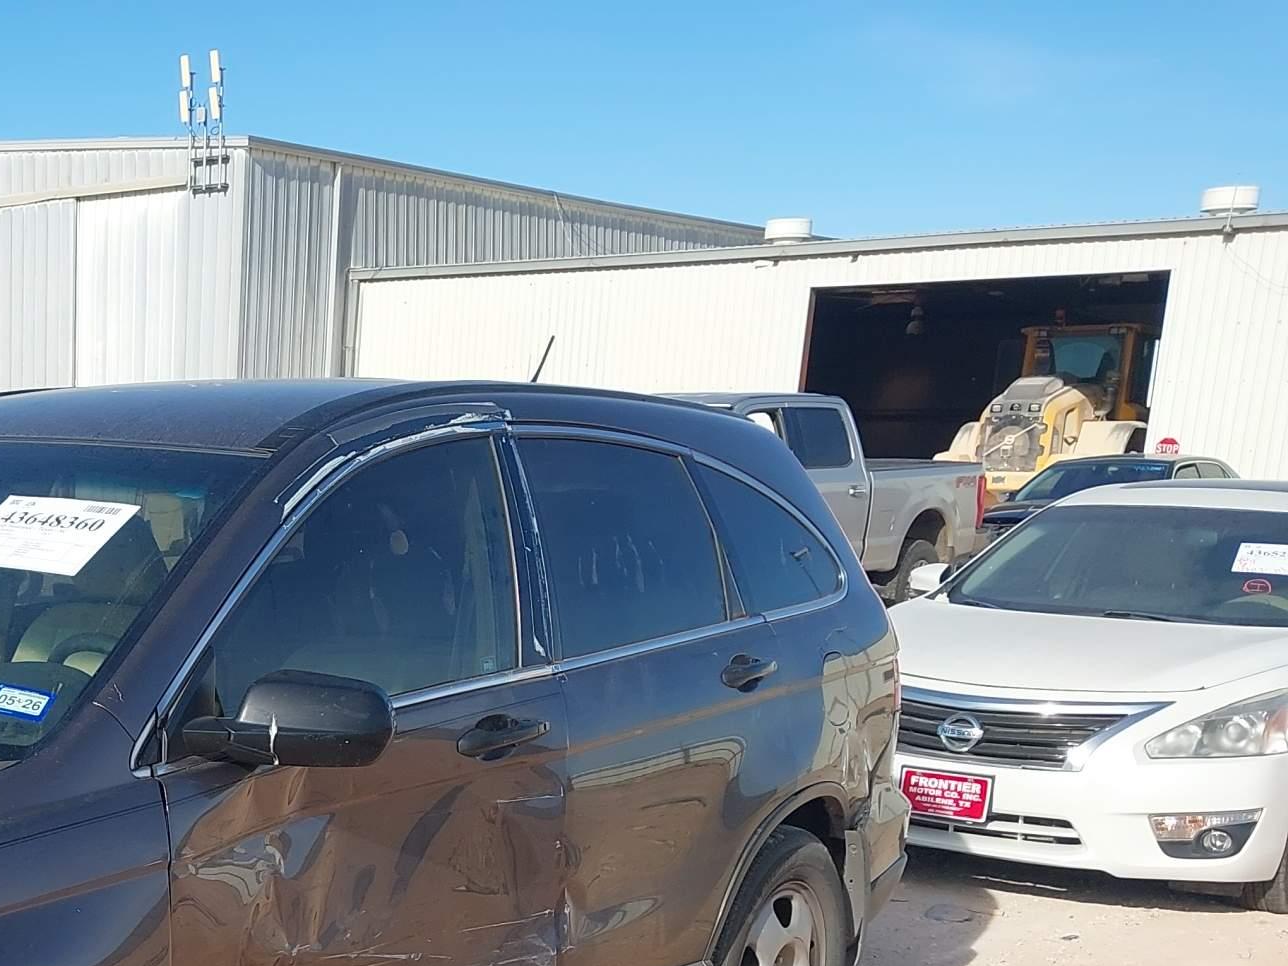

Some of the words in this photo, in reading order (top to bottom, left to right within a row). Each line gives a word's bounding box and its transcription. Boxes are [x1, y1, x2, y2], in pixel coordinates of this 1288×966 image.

[1155, 442, 1179, 454] STOP
[0, 510, 106, 532] 43648360
[21, 698, 42, 711] 26
[940, 727, 976, 737] NISSAN
[910, 775, 982, 794] FRONTIER
[908, 786, 942, 797] MOTOR
[943, 790, 960, 799] CO.
[961, 793, 982, 802] INC.
[915, 795, 956, 807] ABILENE,
[957, 800, 971, 808] TX
